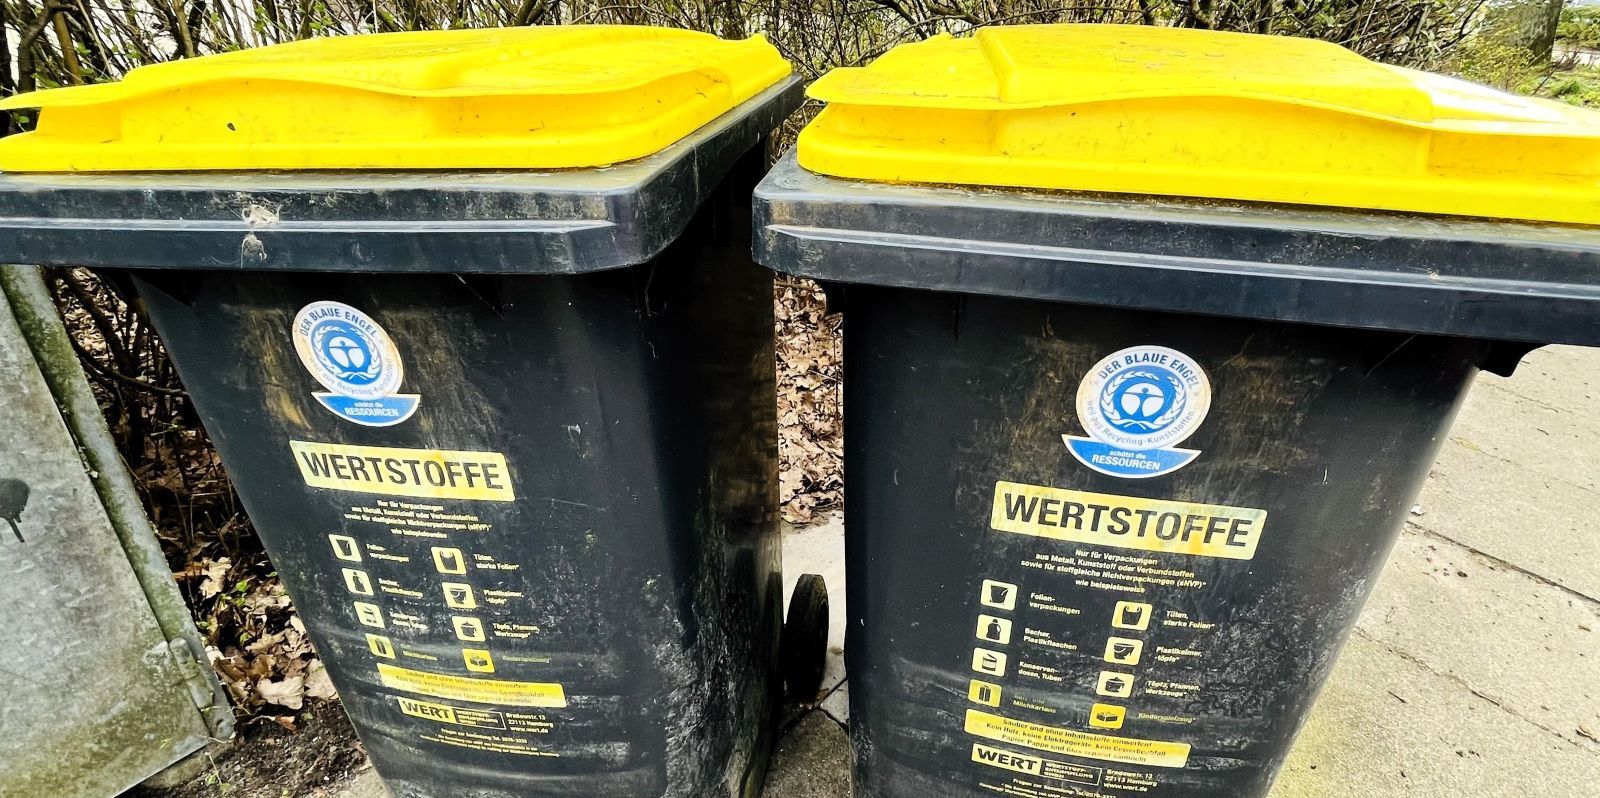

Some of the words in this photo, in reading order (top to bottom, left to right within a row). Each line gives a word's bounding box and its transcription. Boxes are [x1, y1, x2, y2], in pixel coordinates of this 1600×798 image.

[310, 307, 341, 322] BLAUE
[300, 318, 321, 337] DER
[345, 311, 377, 338] ENGEL
[1098, 360, 1121, 380] DER
[1125, 353, 1169, 366] BLAUE
[1170, 359, 1199, 391] ENGEL
[344, 407, 399, 417] RESSOURCEN
[1091, 454, 1161, 471] RESSOURCEN
[1135, 452, 1147, 460] die
[301, 450, 503, 490] WERTSTOFFE
[1004, 492, 1252, 547] WERTSTOFFE
[1075, 549, 1090, 558] Nur
[1090, 550, 1102, 560] für
[1103, 552, 1158, 568] Verpackungen
[1020, 559, 1043, 570] sowie
[1044, 562, 1056, 572] für
[1056, 565, 1101, 579] stoffgleiche
[1101, 569, 1175, 587] Nichtverpackungen
[1035, 553, 1050, 561] aus
[1050, 554, 1077, 566] Metall,
[1077, 558, 1117, 571] Kunststoff
[1117, 564, 1136, 573] oder
[1136, 566, 1196, 580] Verbundstoffen
[1075, 578, 1089, 588] wie
[1089, 580, 1147, 595] beispielsweise
[1030, 592, 1056, 603] Folien-
[1029, 601, 1081, 616] verpackungen
[1166, 610, 1189, 620] Tüten,
[1163, 619, 1188, 628] starke
[1024, 627, 1051, 639] Becher,
[1023, 635, 1078, 651] Plastikflaschen
[1156, 646, 1204, 658] Plastikeimer,
[1019, 661, 1060, 674] Konserven-
[1018, 669, 1041, 680] dosen,
[1041, 672, 1063, 682] Tuben
[402, 701, 450, 720] WERT
[986, 722, 1002, 731] Kein
[1022, 730, 1042, 740] keine
[1002, 718, 1028, 729] Sauber
[1030, 723, 1045, 732] und
[1045, 727, 1063, 736] ohne
[1065, 730, 1112, 743] Inhaltsstoffe
[1112, 738, 1153, 748] einwerfen!
[1027, 738, 1050, 749] Pappe
[977, 748, 1040, 770] WERT
[1105, 775, 1127, 784] 22113
[1127, 777, 1158, 788] Hamburg
[1144, 772, 1153, 780] 13
[1103, 783, 1149, 793] www.wert.de
